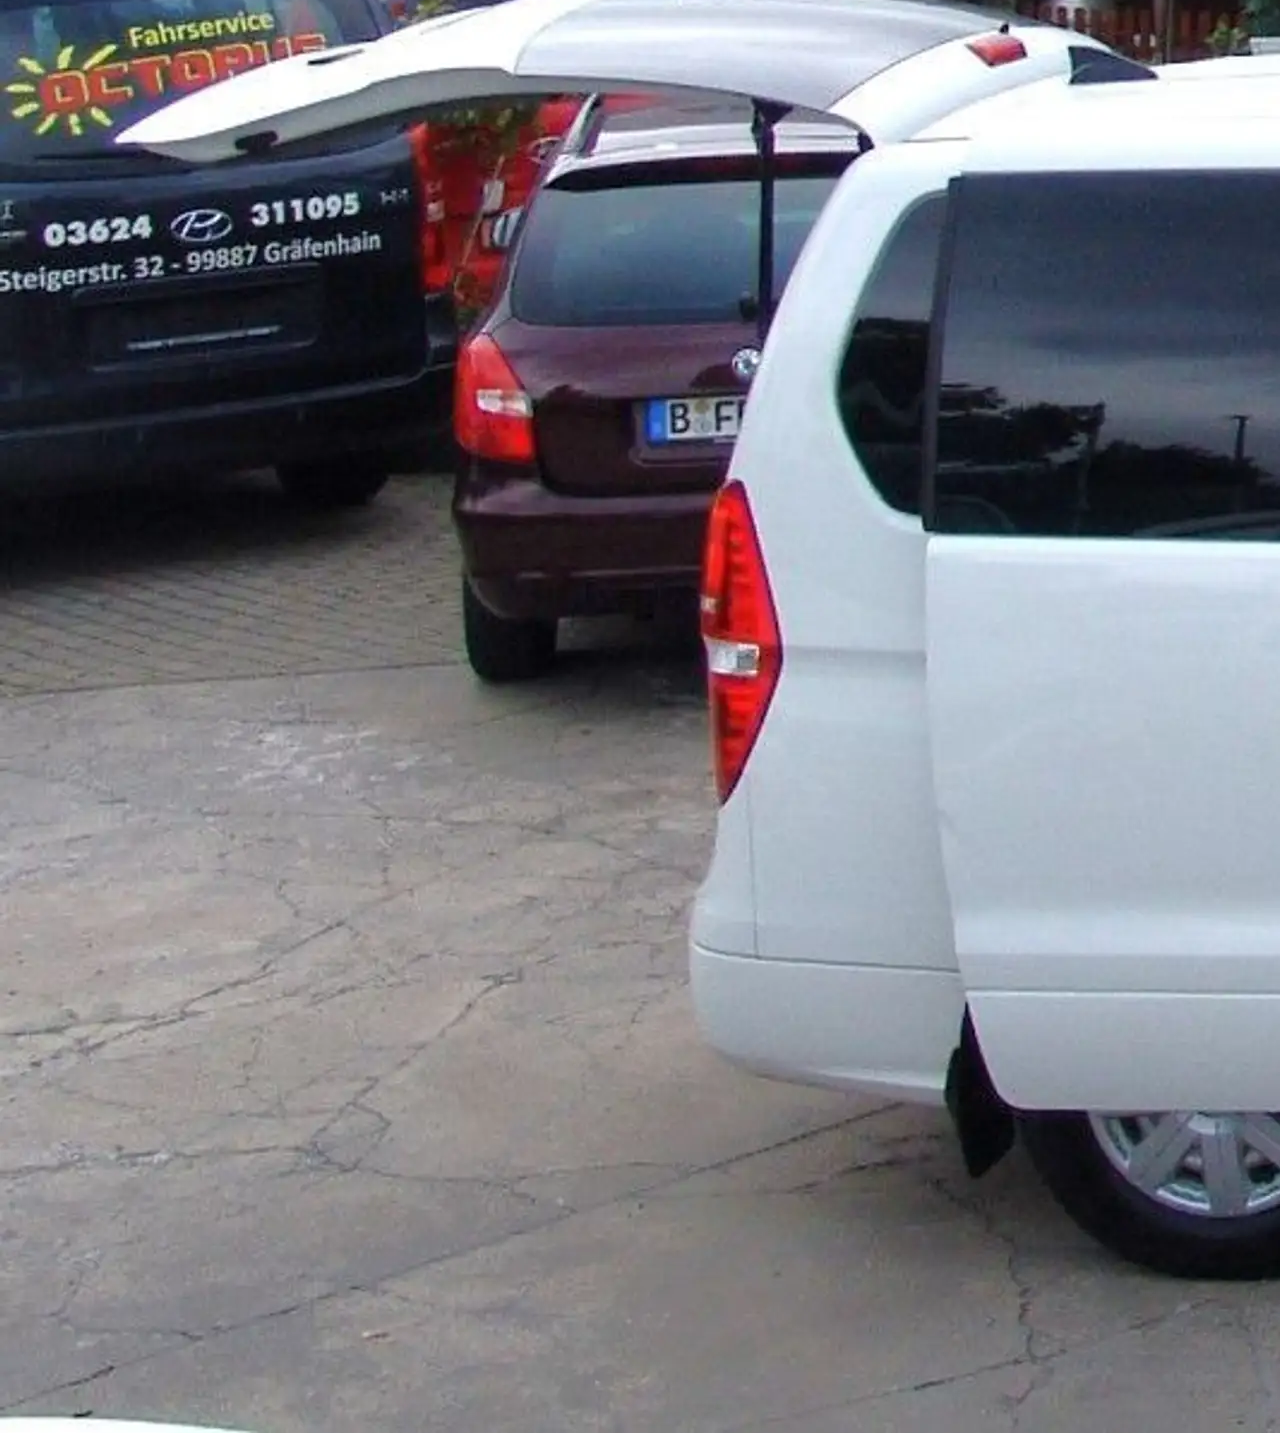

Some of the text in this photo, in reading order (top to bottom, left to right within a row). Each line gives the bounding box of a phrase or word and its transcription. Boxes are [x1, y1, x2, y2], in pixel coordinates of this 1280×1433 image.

[129, 11, 275, 48] Fahrservice
[44, 192, 361, 248] 03624 311095
[0, 262, 127, 292] Steigerstr.
[134, 255, 165, 279] 32
[186, 244, 257, 273] 99887
[264, 231, 381, 264] Gräfenhain
[669, 403, 690, 433] B
